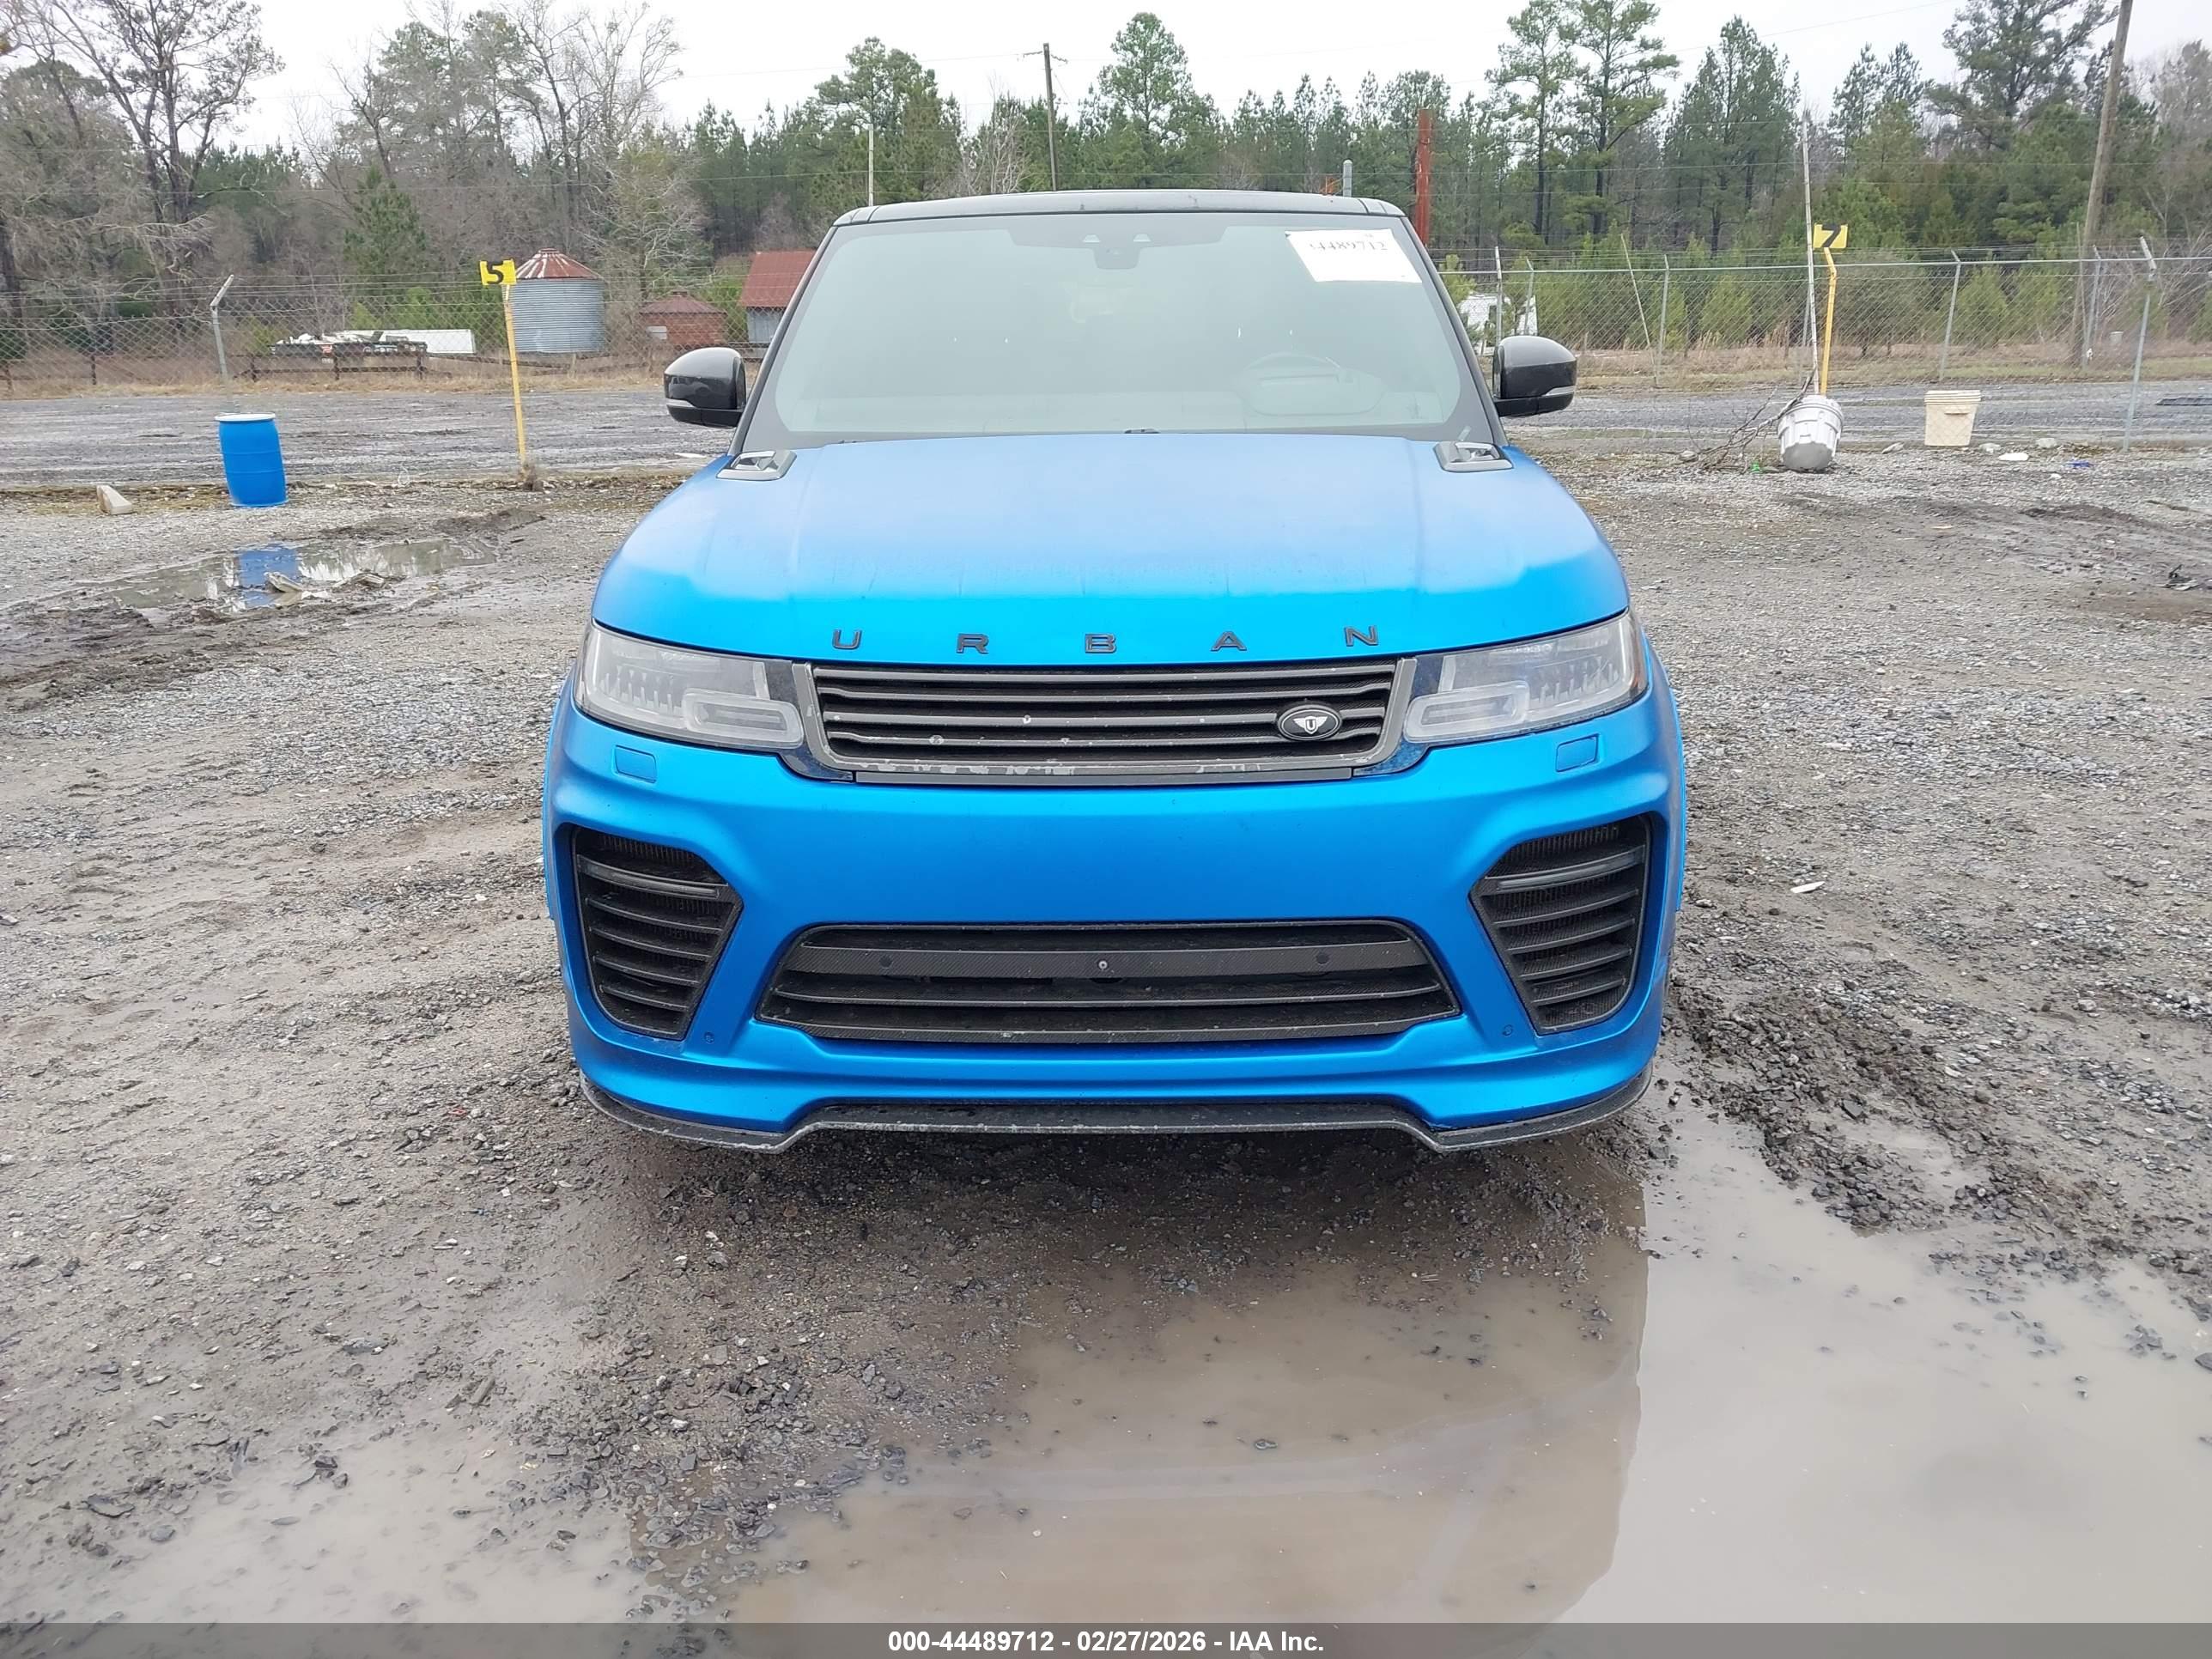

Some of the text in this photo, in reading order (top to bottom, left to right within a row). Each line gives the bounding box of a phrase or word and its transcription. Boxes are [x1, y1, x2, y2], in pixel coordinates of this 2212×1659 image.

[1821, 223, 1841, 247] 7
[486, 259, 504, 284] 5
[832, 626, 1378, 653] URBAN
